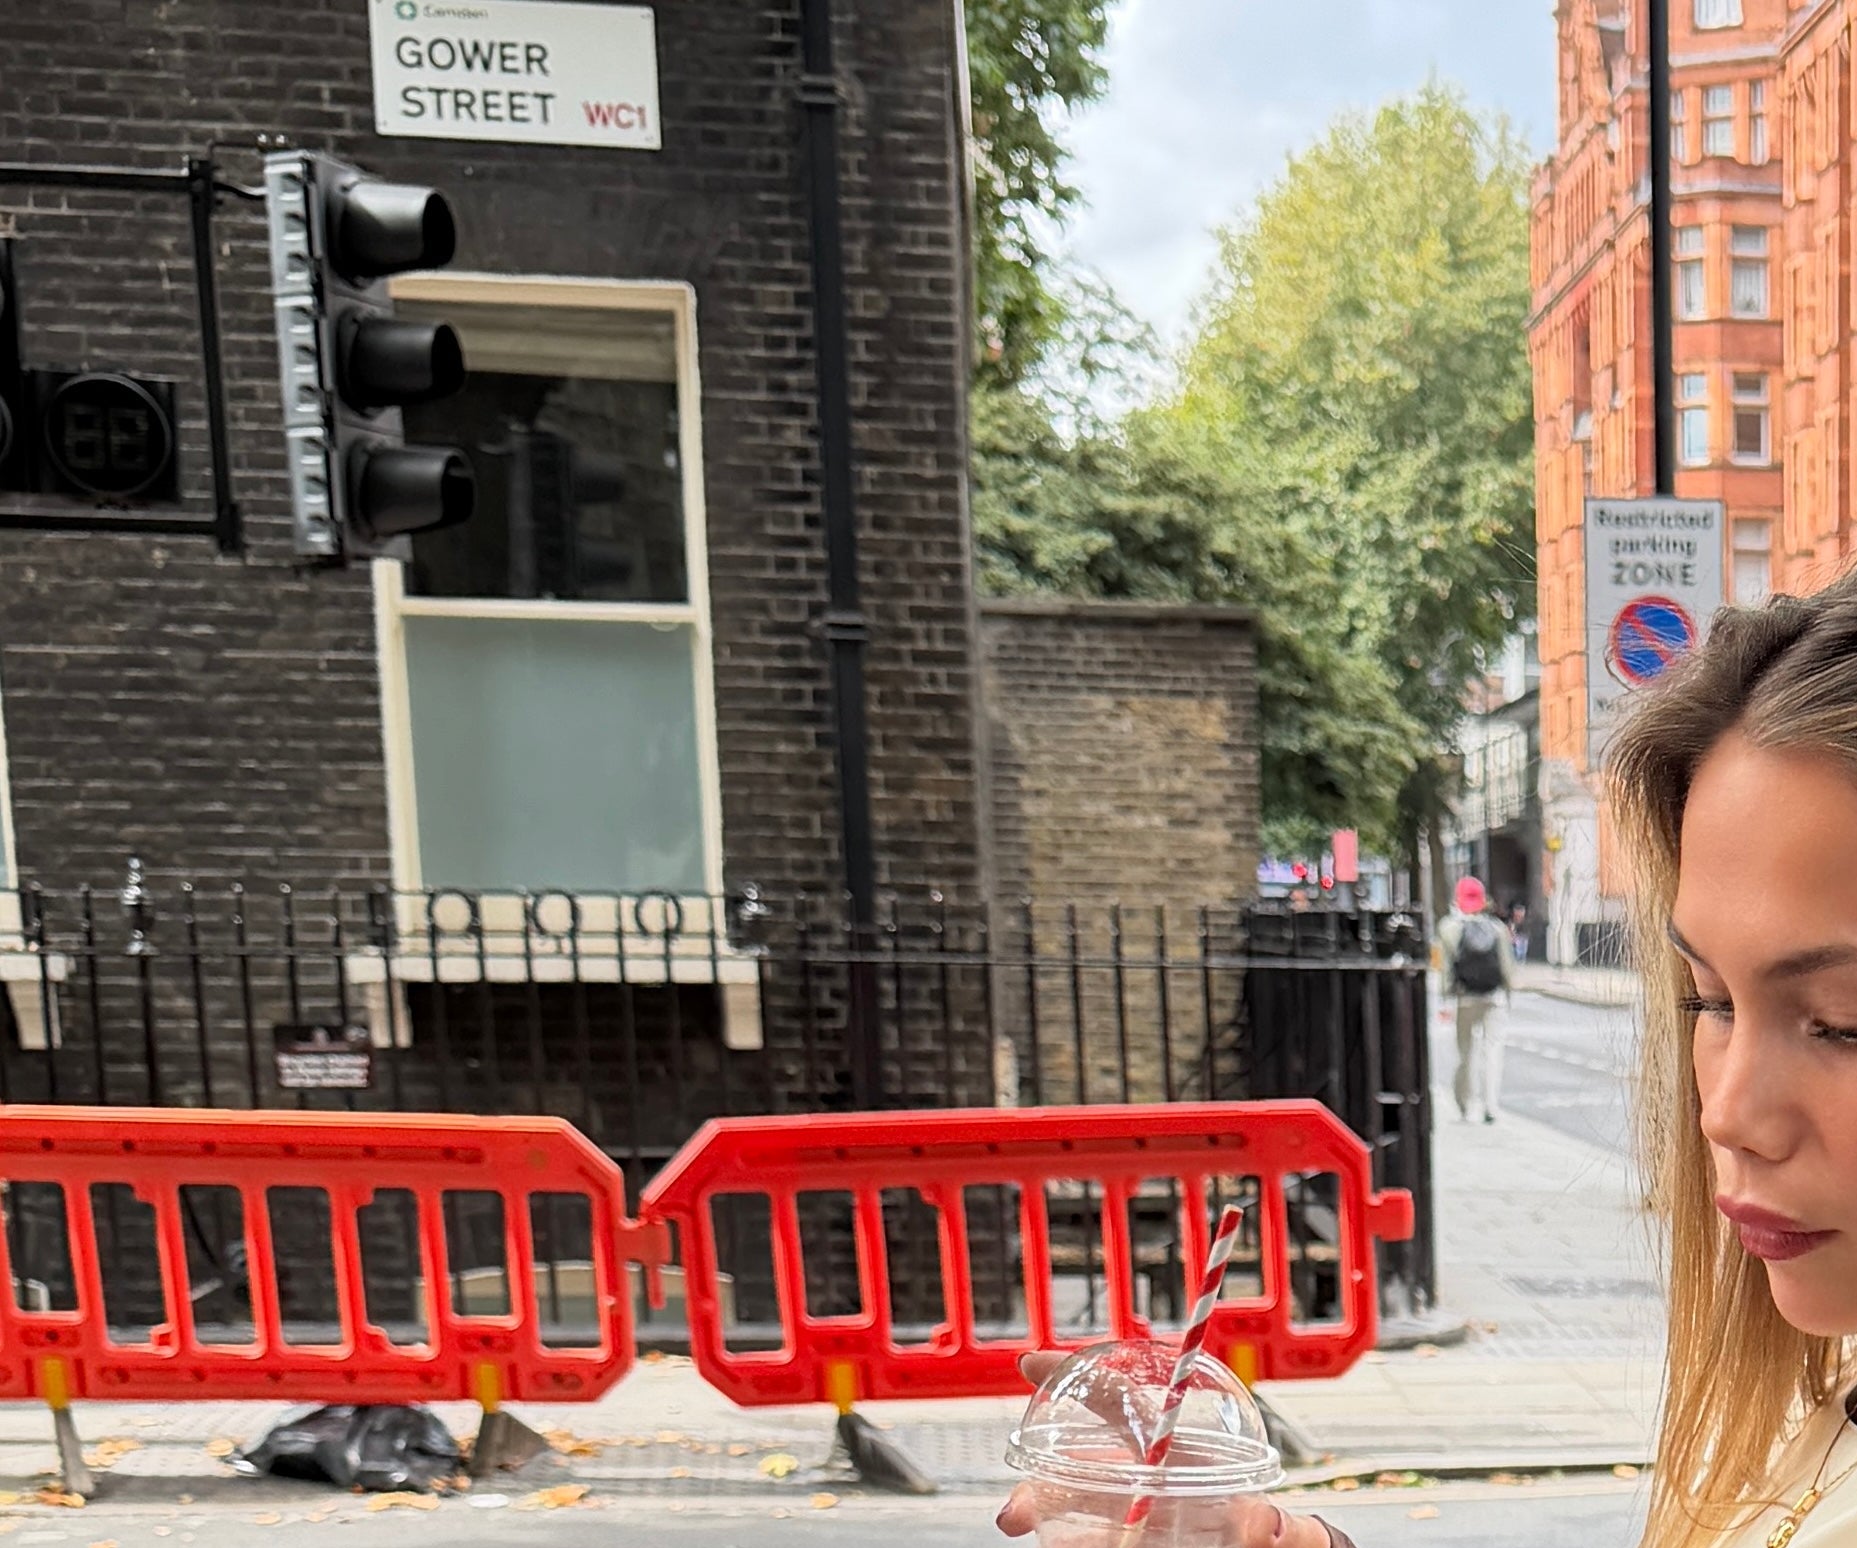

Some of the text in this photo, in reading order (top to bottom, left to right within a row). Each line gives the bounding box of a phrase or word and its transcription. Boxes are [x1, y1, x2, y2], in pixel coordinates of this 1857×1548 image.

[396, 37, 550, 76] GOWER
[402, 86, 648, 129] STREET WC1
[1609, 562, 1698, 586] ZONE
